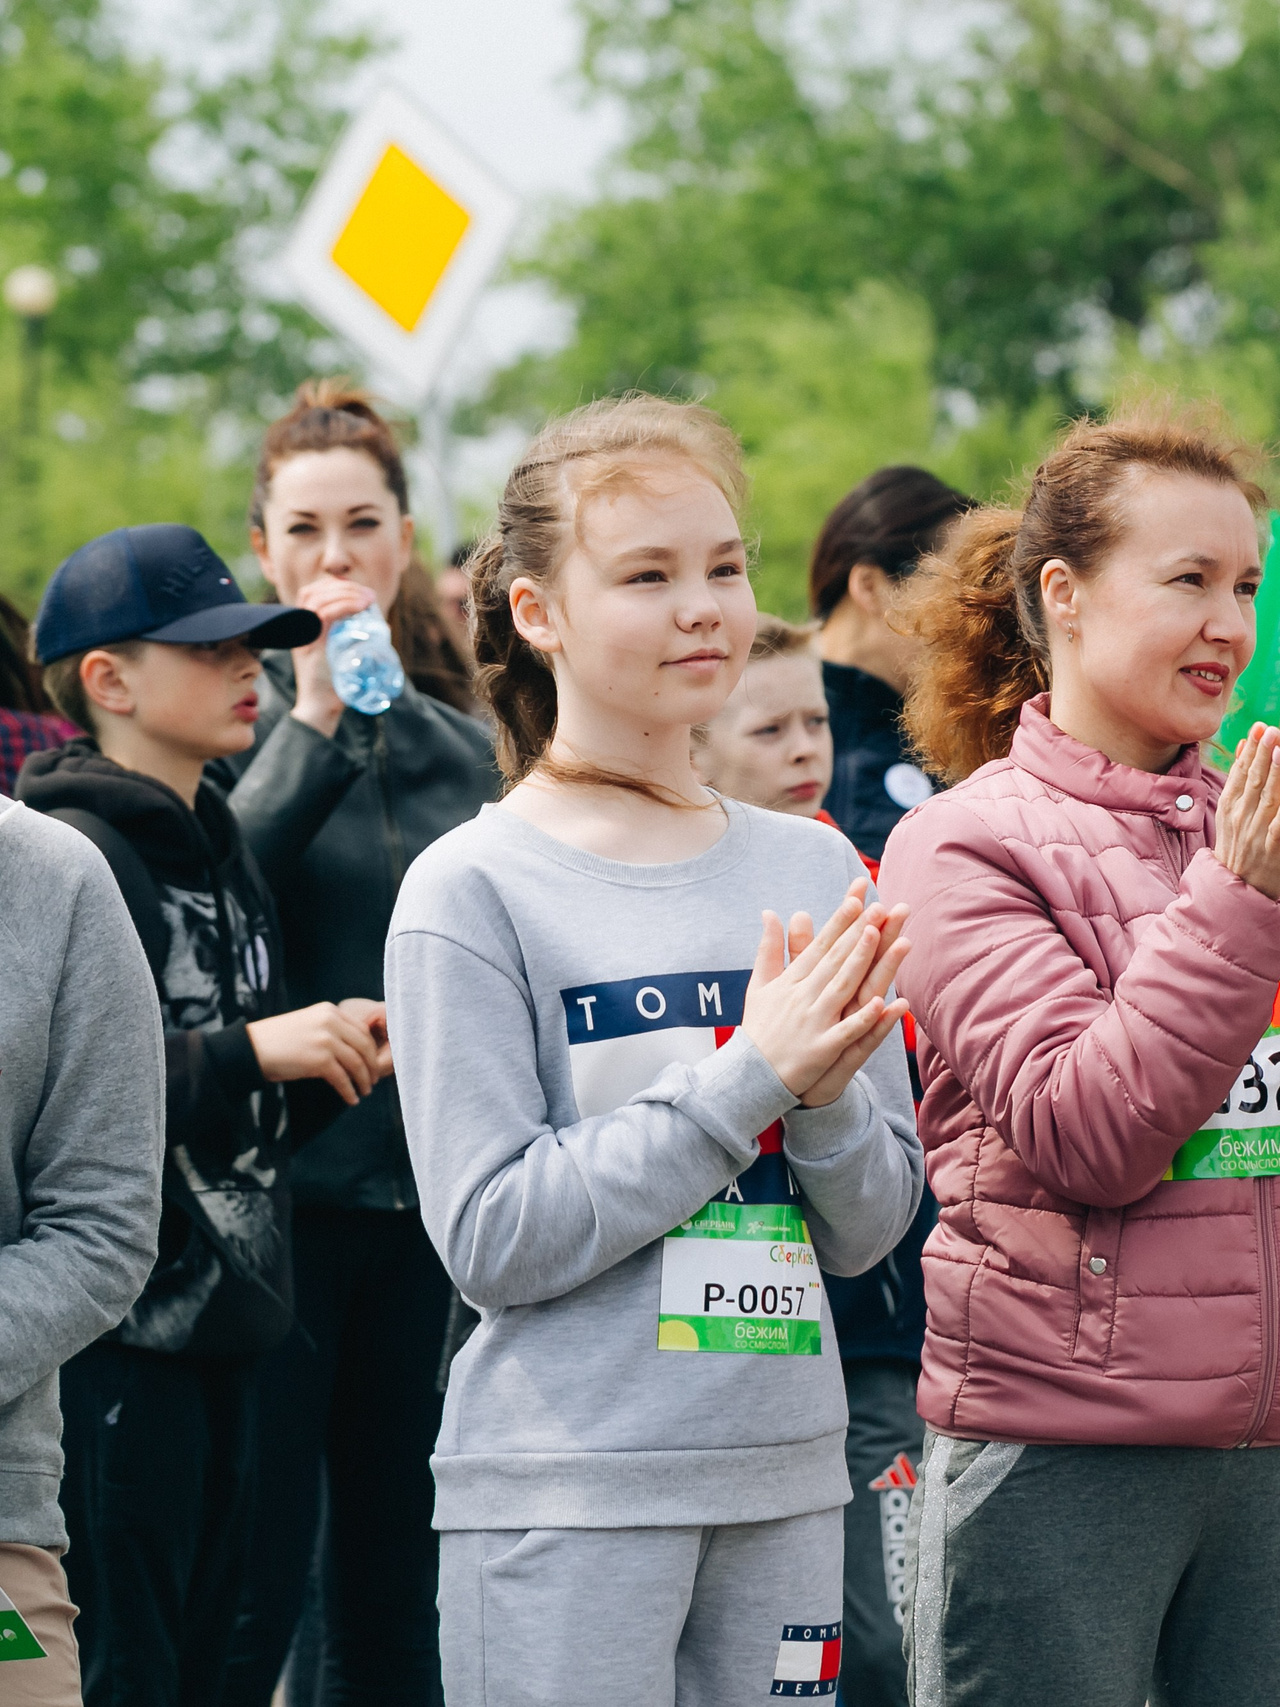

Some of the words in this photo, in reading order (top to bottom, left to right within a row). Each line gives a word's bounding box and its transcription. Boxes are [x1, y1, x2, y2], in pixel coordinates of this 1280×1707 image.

[703, 1283, 805, 1316] P-0057
[734, 1321, 788, 1340] бежим
[787, 1625, 842, 1639] TOMM
